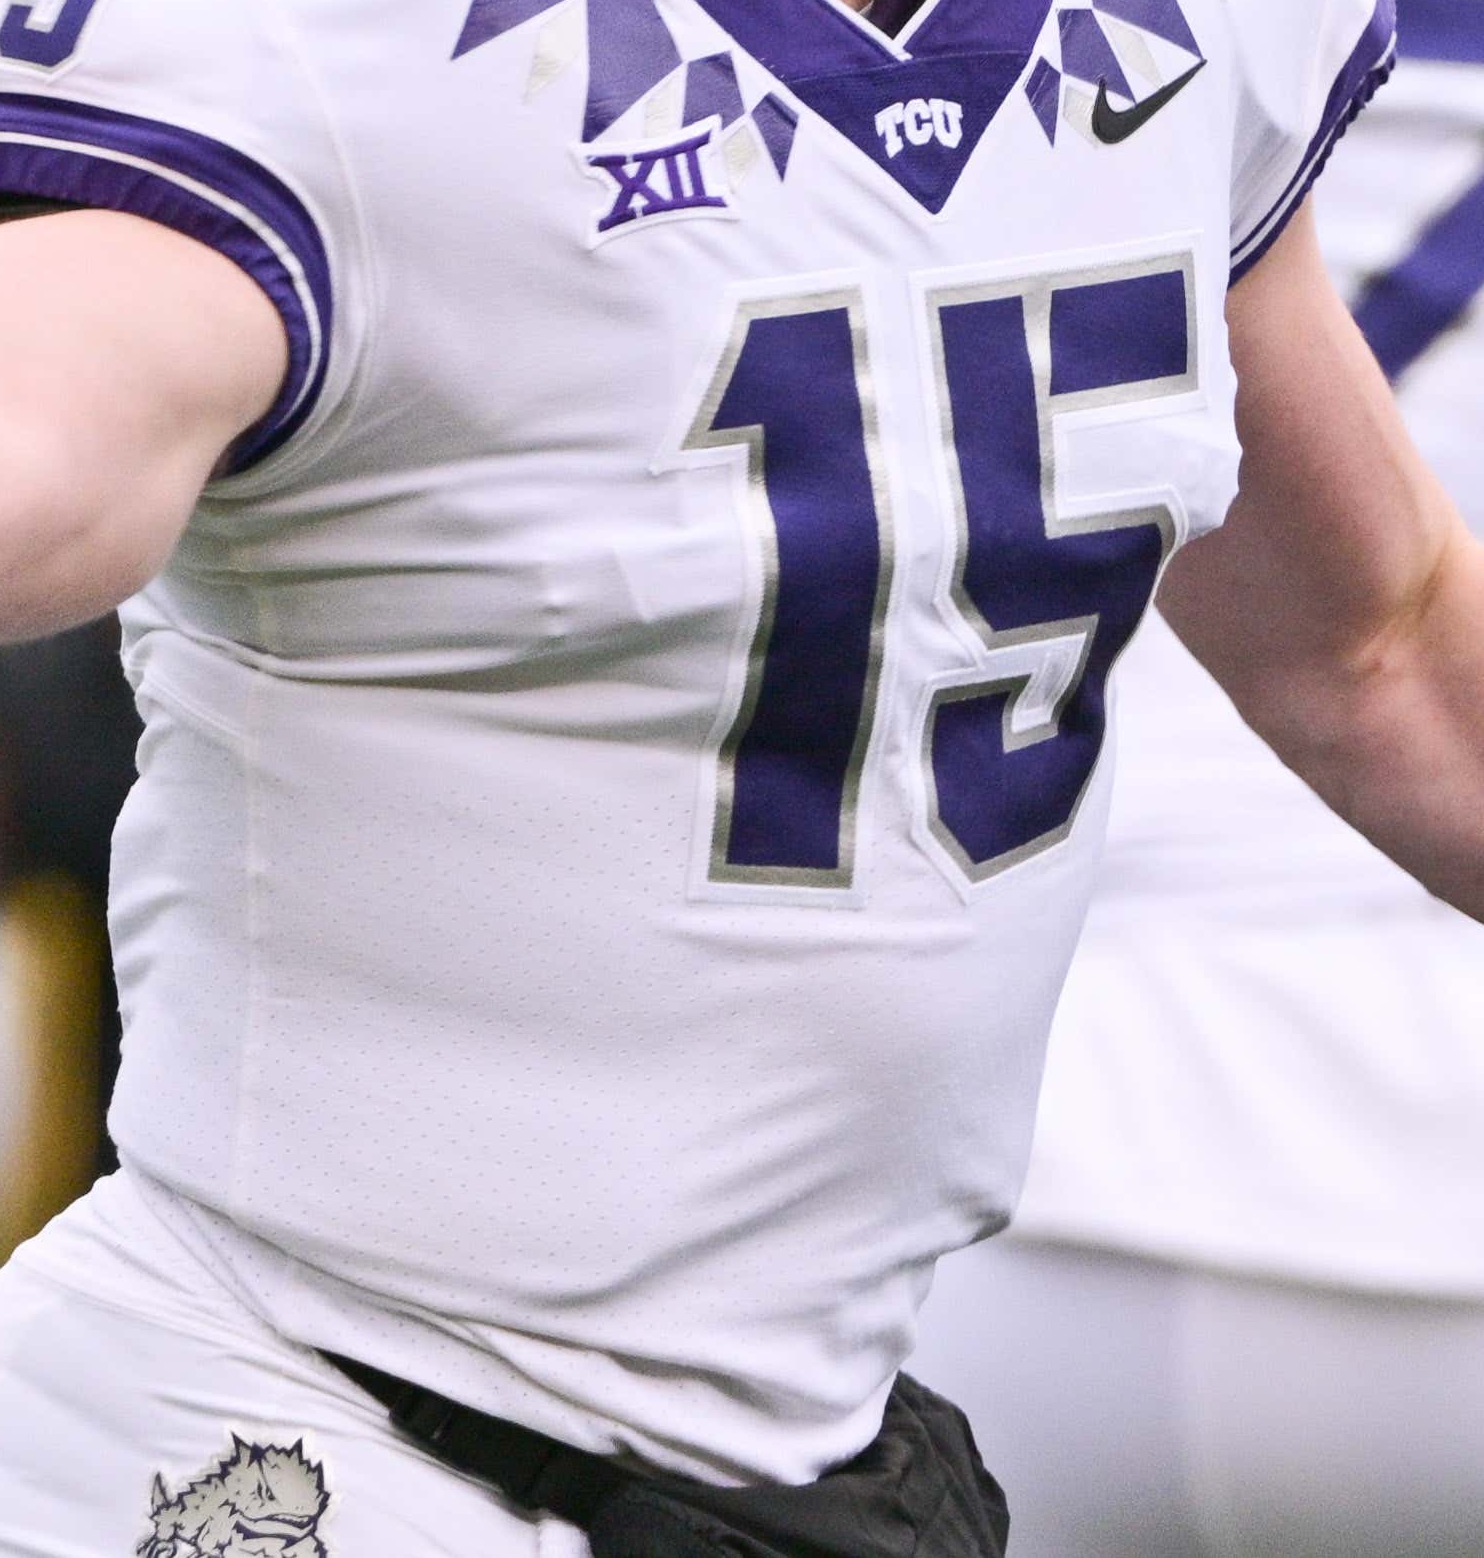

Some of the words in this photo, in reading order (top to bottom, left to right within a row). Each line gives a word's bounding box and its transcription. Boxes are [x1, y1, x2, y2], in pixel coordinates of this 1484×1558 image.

[874, 96, 965, 159] TCU
[589, 128, 727, 233] XII
[676, 250, 1201, 890] 15
